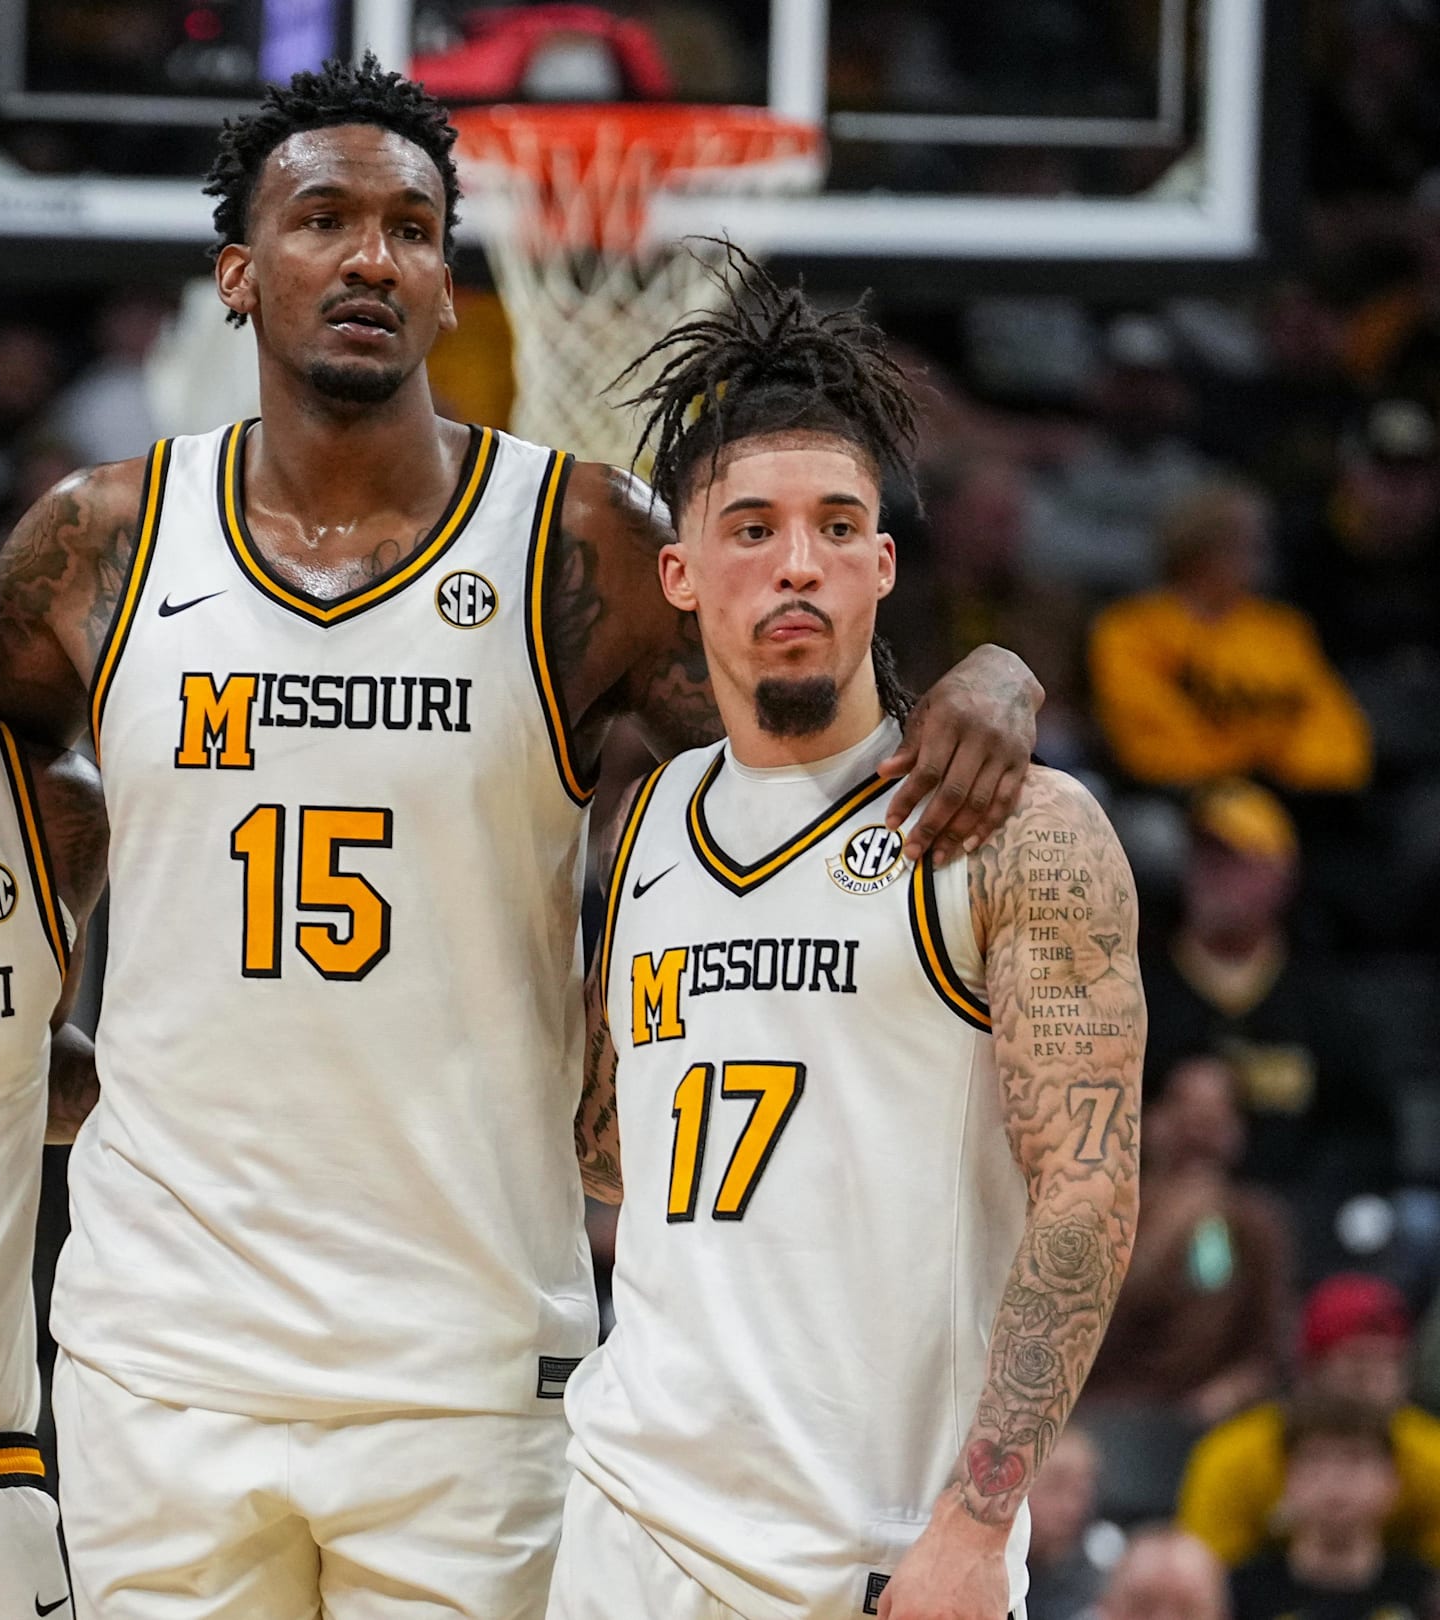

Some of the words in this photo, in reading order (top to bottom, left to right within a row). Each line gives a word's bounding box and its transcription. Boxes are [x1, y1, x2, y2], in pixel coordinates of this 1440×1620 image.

[441, 571, 494, 626] SEC
[174, 671, 472, 772] MISSOURI
[846, 828, 901, 876] SEC
[230, 803, 393, 982] 15
[833, 869, 894, 893] GRADUATE
[1028, 888, 1060, 901] THE
[1029, 906, 1068, 921] LION
[1073, 906, 1094, 921] OF
[1029, 926, 1059, 941] THE
[1029, 947, 1073, 961] TRIBE
[1030, 967, 1051, 980] OF
[630, 938, 859, 1047] MISSOURI
[1031, 1004, 1080, 1018] HATH
[666, 1060, 807, 1224] 17
[1067, 1083, 1124, 1165] 7
